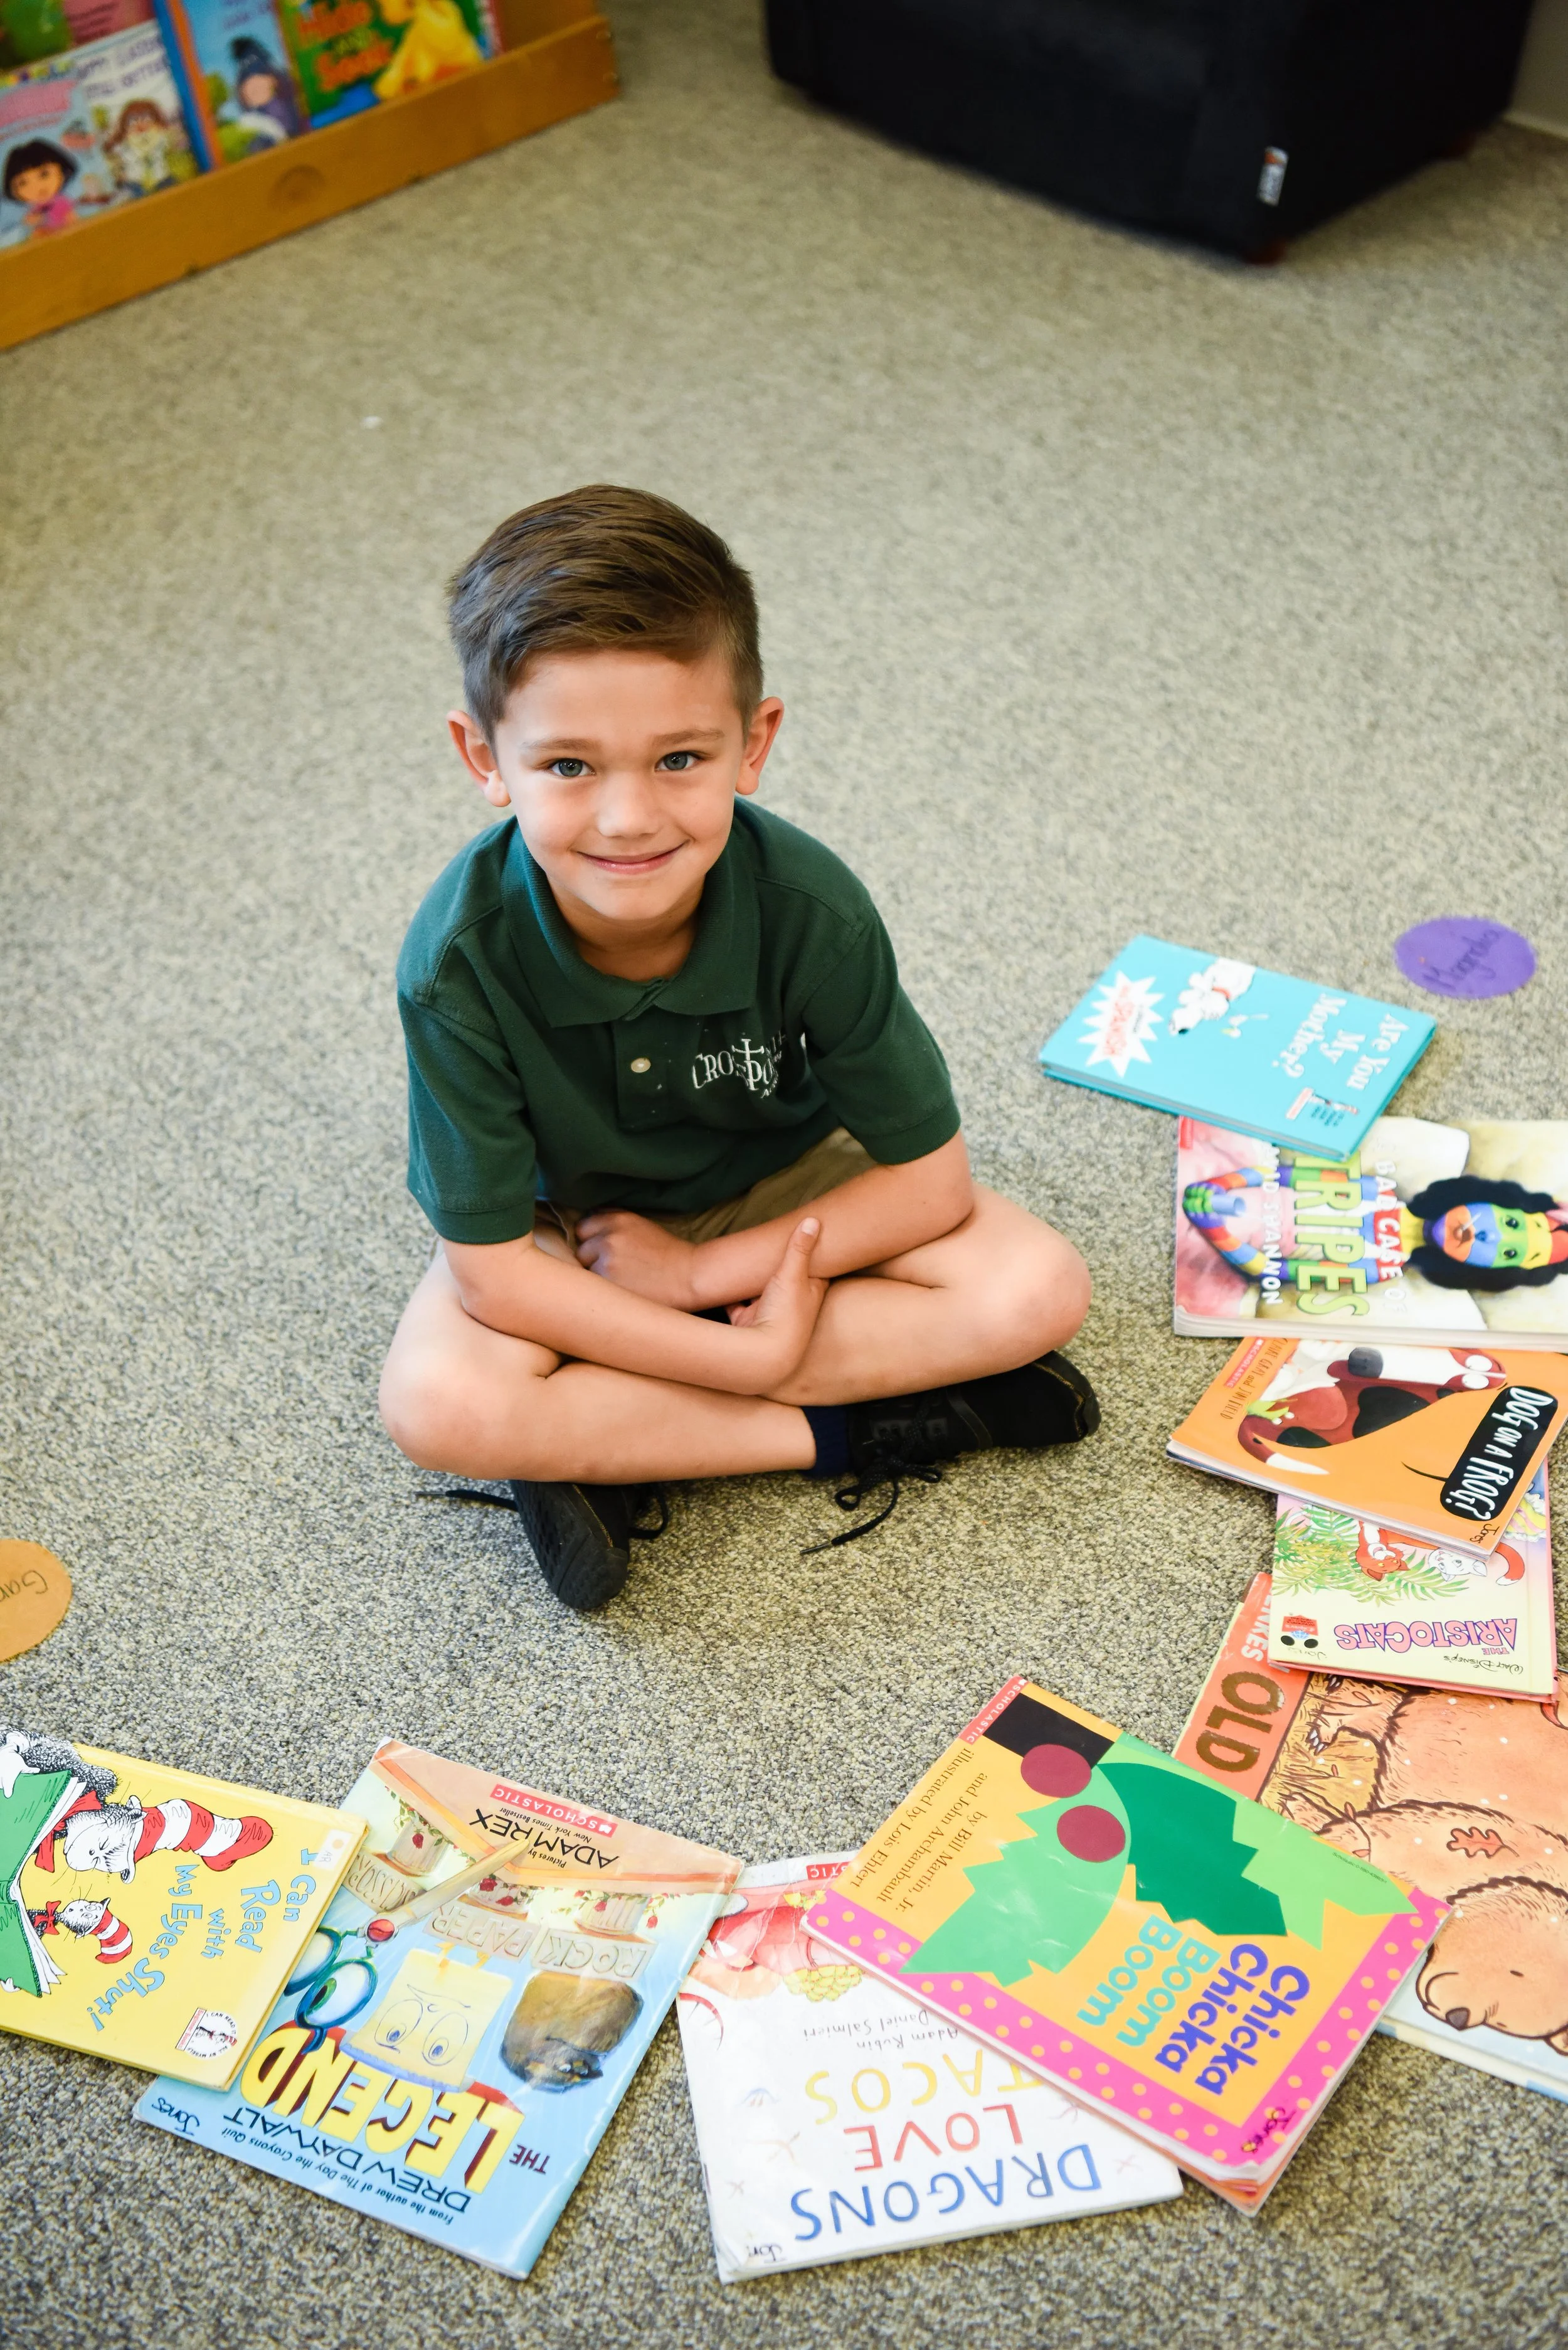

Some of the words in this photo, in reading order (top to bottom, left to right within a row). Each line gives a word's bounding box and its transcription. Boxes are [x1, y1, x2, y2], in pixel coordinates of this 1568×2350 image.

[1271, 993, 1347, 1078] Mother?
[1319, 1029, 1366, 1065] My
[1370, 1013, 1410, 1052] Are
[1346, 1054, 1391, 1090] You
[1375, 1161, 1397, 1210] BAD
[1295, 1151, 1370, 1316] TRIPES
[1377, 1218, 1404, 1280] CASE
[1261, 1201, 1283, 1305] SHANNON
[1226, 1344, 1261, 1388] SCHOLASTIC
[1242, 1374, 1256, 1388] and
[1251, 1358, 1273, 1378] GRAY
[1220, 1400, 1243, 1420] FIELD
[1491, 1387, 1554, 1430] DOG
[1483, 1443, 1513, 1459] A
[1333, 1618, 1518, 1654] ARISTOCATS
[1481, 1647, 1510, 1656] THE
[966, 1685, 1021, 1744] SCHOLASTIC
[1196, 1671, 1285, 1773] OLD
[920, 1747, 975, 1807] illustrated
[965, 1773, 988, 1798] and
[469, 1808, 534, 1841] REX
[494, 1788, 598, 1830] SCHOLASTIC
[499, 1807, 531, 1824] Bestseller
[532, 1818, 553, 1831] Times
[906, 1805, 927, 1822] by
[940, 1797, 971, 1826] John
[967, 1811, 988, 1827] by
[554, 1826, 572, 1837] York
[573, 1832, 592, 1844] New
[884, 1822, 911, 1849] Lois
[948, 1827, 973, 1853] Bill
[527, 1848, 538, 1859] by
[533, 1831, 620, 1869] ADAM
[538, 1851, 567, 1868] Pictures
[876, 1826, 945, 1903] Archambault
[168, 1864, 201, 1897] My
[347, 1856, 417, 1911] SCISSOR
[850, 1849, 889, 1889] Ehlert
[908, 1851, 954, 1893] Martin,
[283, 1874, 317, 1922] Can
[895, 1896, 915, 1913] Jr.
[149, 1903, 203, 1960] Eyes
[200, 1908, 231, 1959] with
[235, 1879, 282, 1954] Read
[432, 1905, 535, 1958] PAPER
[541, 1935, 649, 1978] ROCK
[1076, 1914, 1184, 2027] Boom
[86, 1957, 166, 2032] Shut!
[1116, 1937, 1222, 2048] Boom
[1155, 1943, 1269, 2074] Chicka
[225, 2015, 236, 2029] READ
[803, 2020, 872, 2042] Salmieri
[879, 2009, 930, 2026] Daniel
[911, 2027, 958, 2044] Adam
[1195, 1965, 1310, 2096] Chicka
[856, 2033, 904, 2051] Rubin
[805, 2049, 1044, 2126] TACOS
[240, 2020, 526, 2195] LEGEND
[221, 2127, 246, 2143] Quit
[223, 2107, 363, 2171] DAYWALT
[250, 2137, 293, 2161] Crayons
[844, 2103, 1025, 2172] LOVE
[295, 2155, 313, 2170] the
[315, 2164, 338, 2179] Day
[509, 2144, 551, 2175] THE
[341, 2174, 361, 2189] The
[360, 2181, 373, 2194] of
[363, 2161, 472, 2214] DREW
[376, 2187, 408, 2206] author
[790, 2144, 1102, 2241] DRAGONS
[410, 2201, 426, 2215] the
[428, 2207, 454, 2226] From
